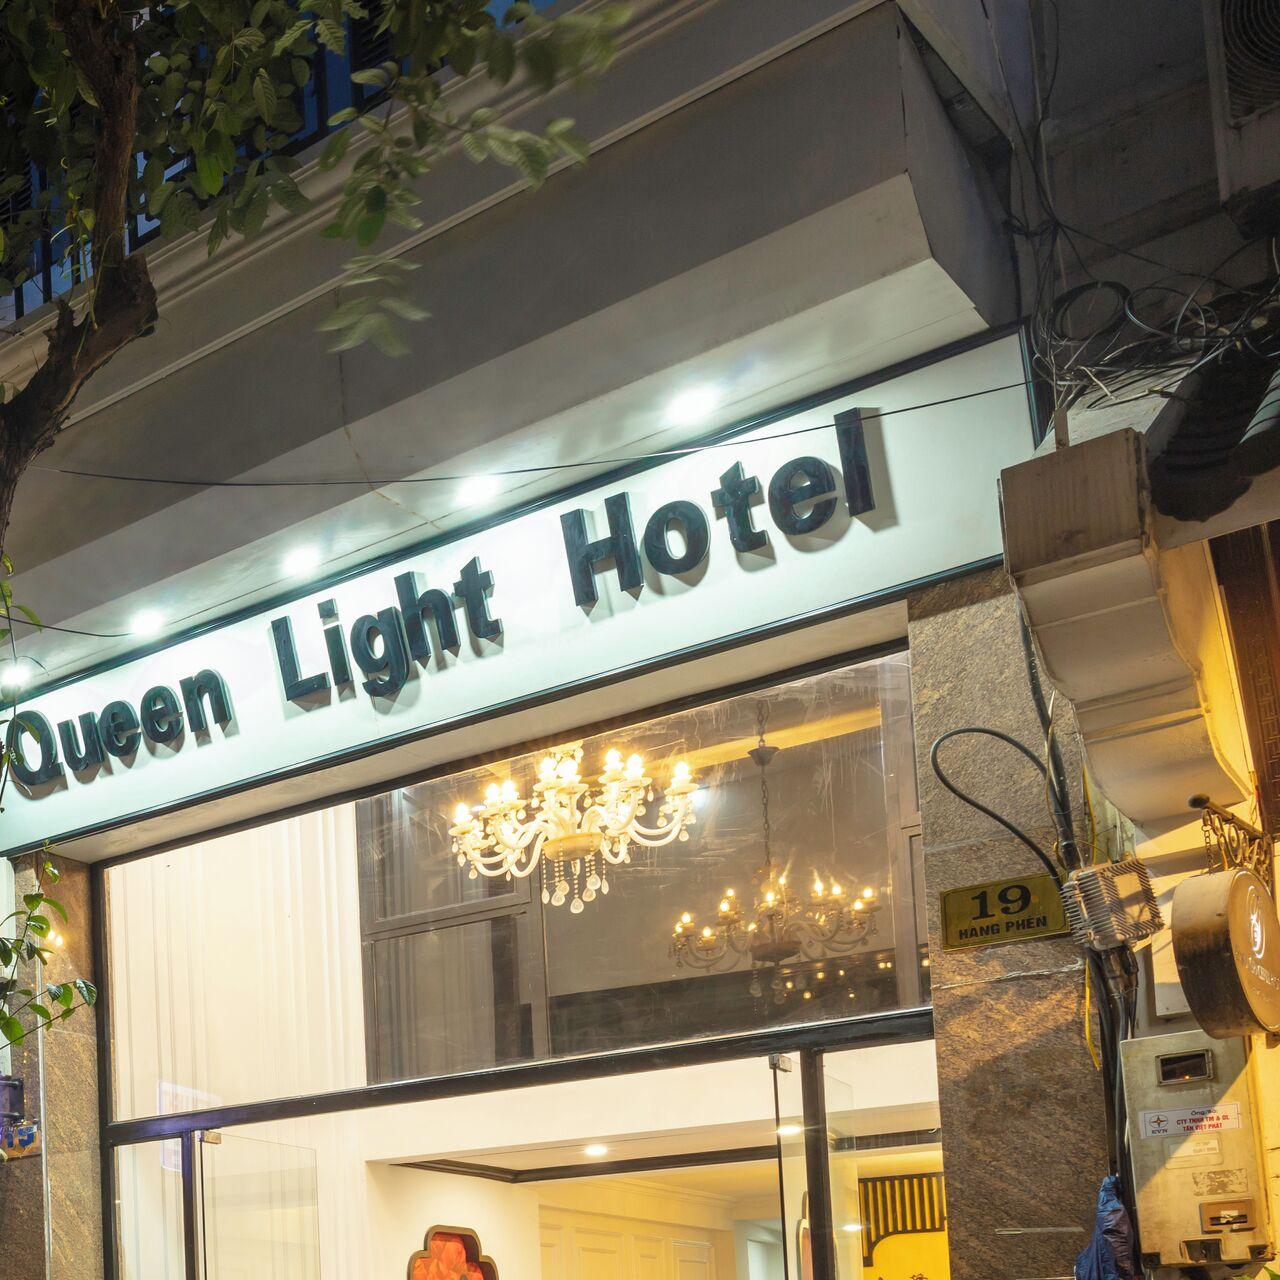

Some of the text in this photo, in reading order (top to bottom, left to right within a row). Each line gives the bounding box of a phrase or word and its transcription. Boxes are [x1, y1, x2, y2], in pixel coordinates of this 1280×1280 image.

[6, 406, 880, 790] Queen Light Hotel
[971, 885, 1032, 920] 19
